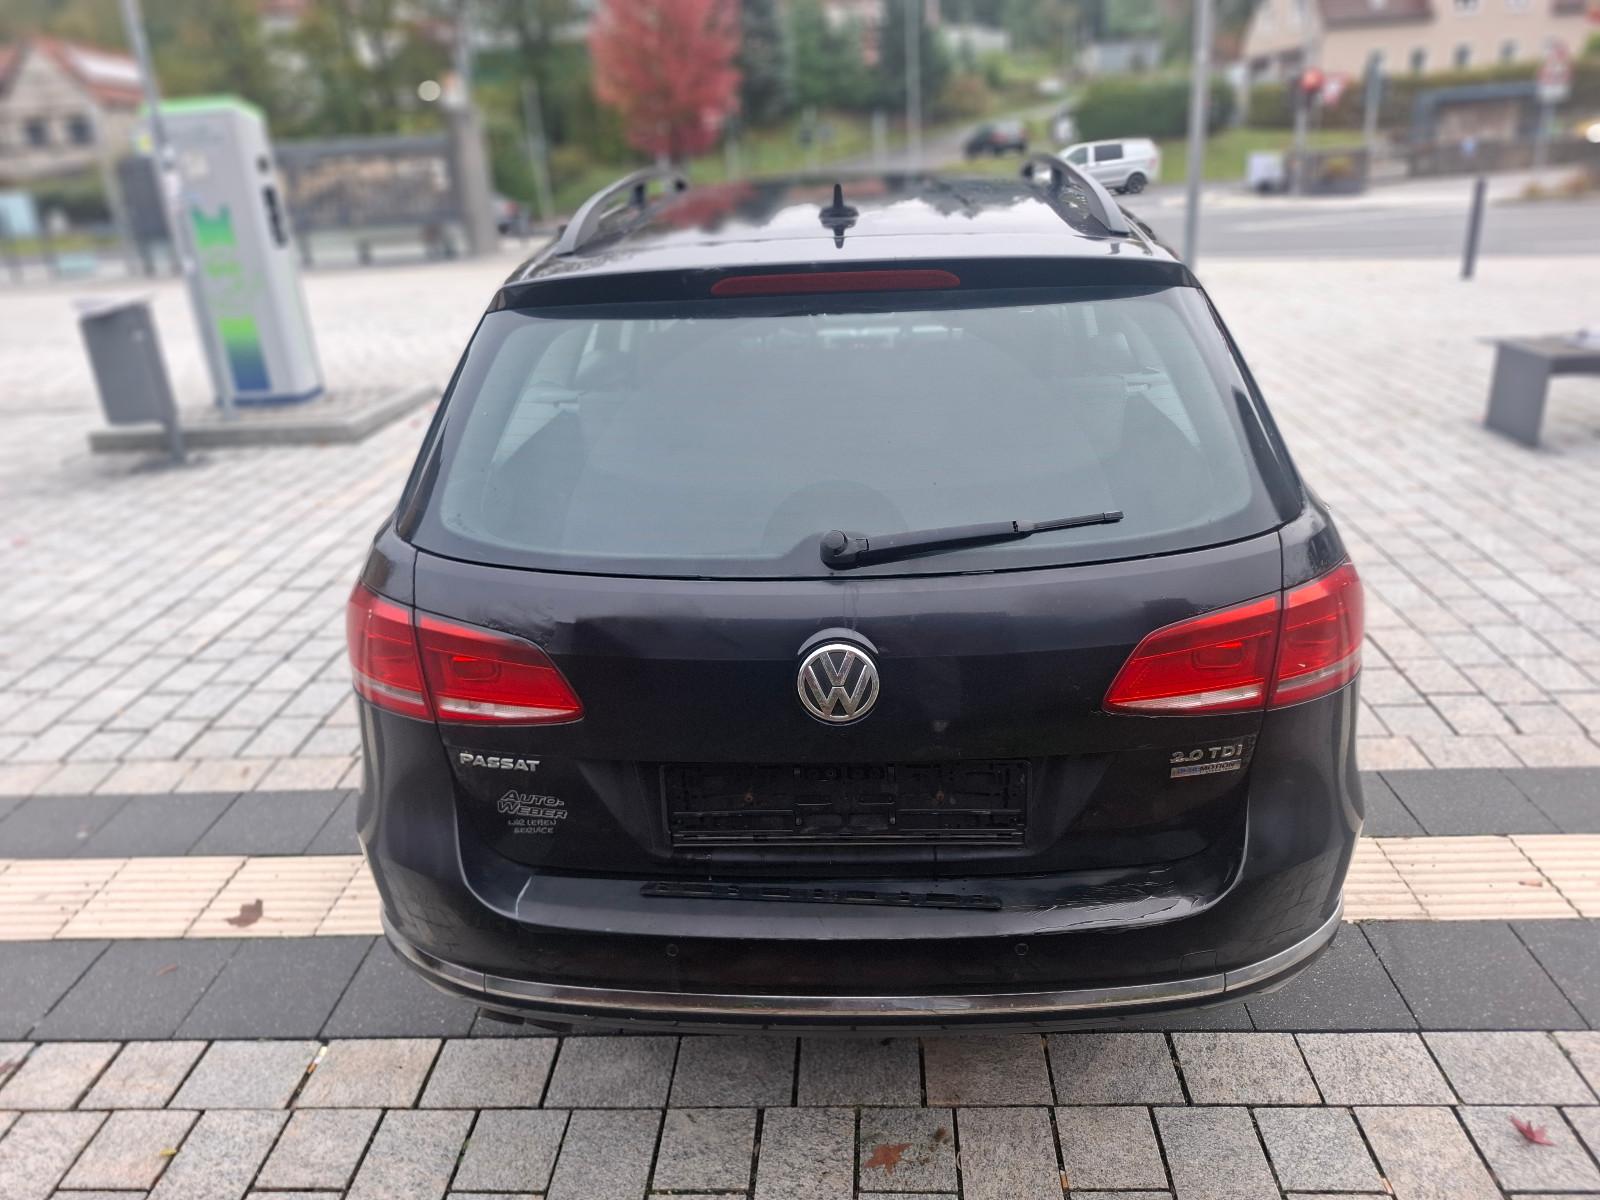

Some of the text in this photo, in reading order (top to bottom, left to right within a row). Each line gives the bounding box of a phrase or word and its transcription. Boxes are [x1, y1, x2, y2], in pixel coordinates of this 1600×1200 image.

[459, 752, 540, 772] PASSAT
[1169, 749, 1204, 763] 2.0
[497, 800, 568, 819] WEBER
